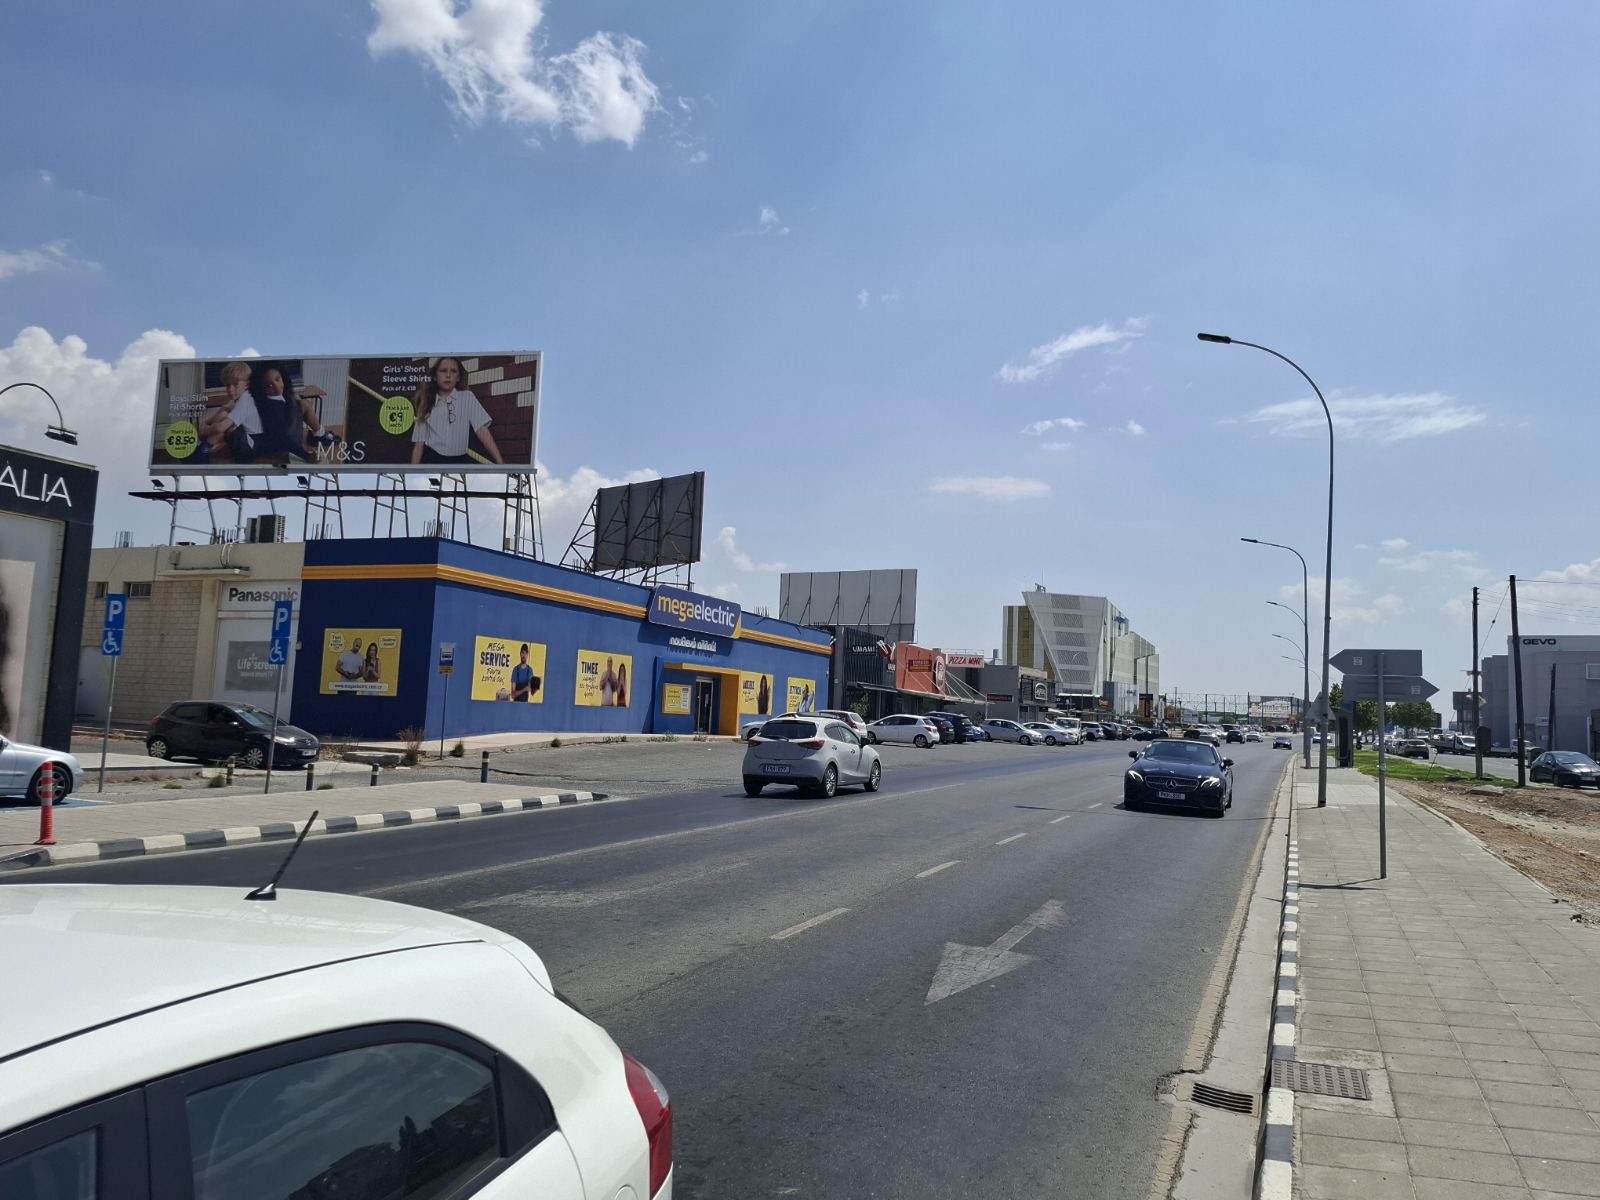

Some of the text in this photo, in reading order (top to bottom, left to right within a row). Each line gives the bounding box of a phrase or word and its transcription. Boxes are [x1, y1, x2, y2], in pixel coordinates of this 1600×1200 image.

[404, 365, 426, 373] Short
[382, 375, 432, 383] Sleeve Shirts
[389, 412, 403, 422] €9
[167, 435, 196, 446] €8.50
[317, 441, 366, 461] M&S
[0, 465, 72, 507] ALIA
[228, 587, 299, 602] Panasonic
[108, 600, 123, 622] P
[275, 607, 289, 630] P
[657, 595, 735, 627] megaelectric
[1522, 638, 1557, 646] GEVO
[480, 651, 510, 668] SERVICE
[949, 656, 966, 665] PIZZA
